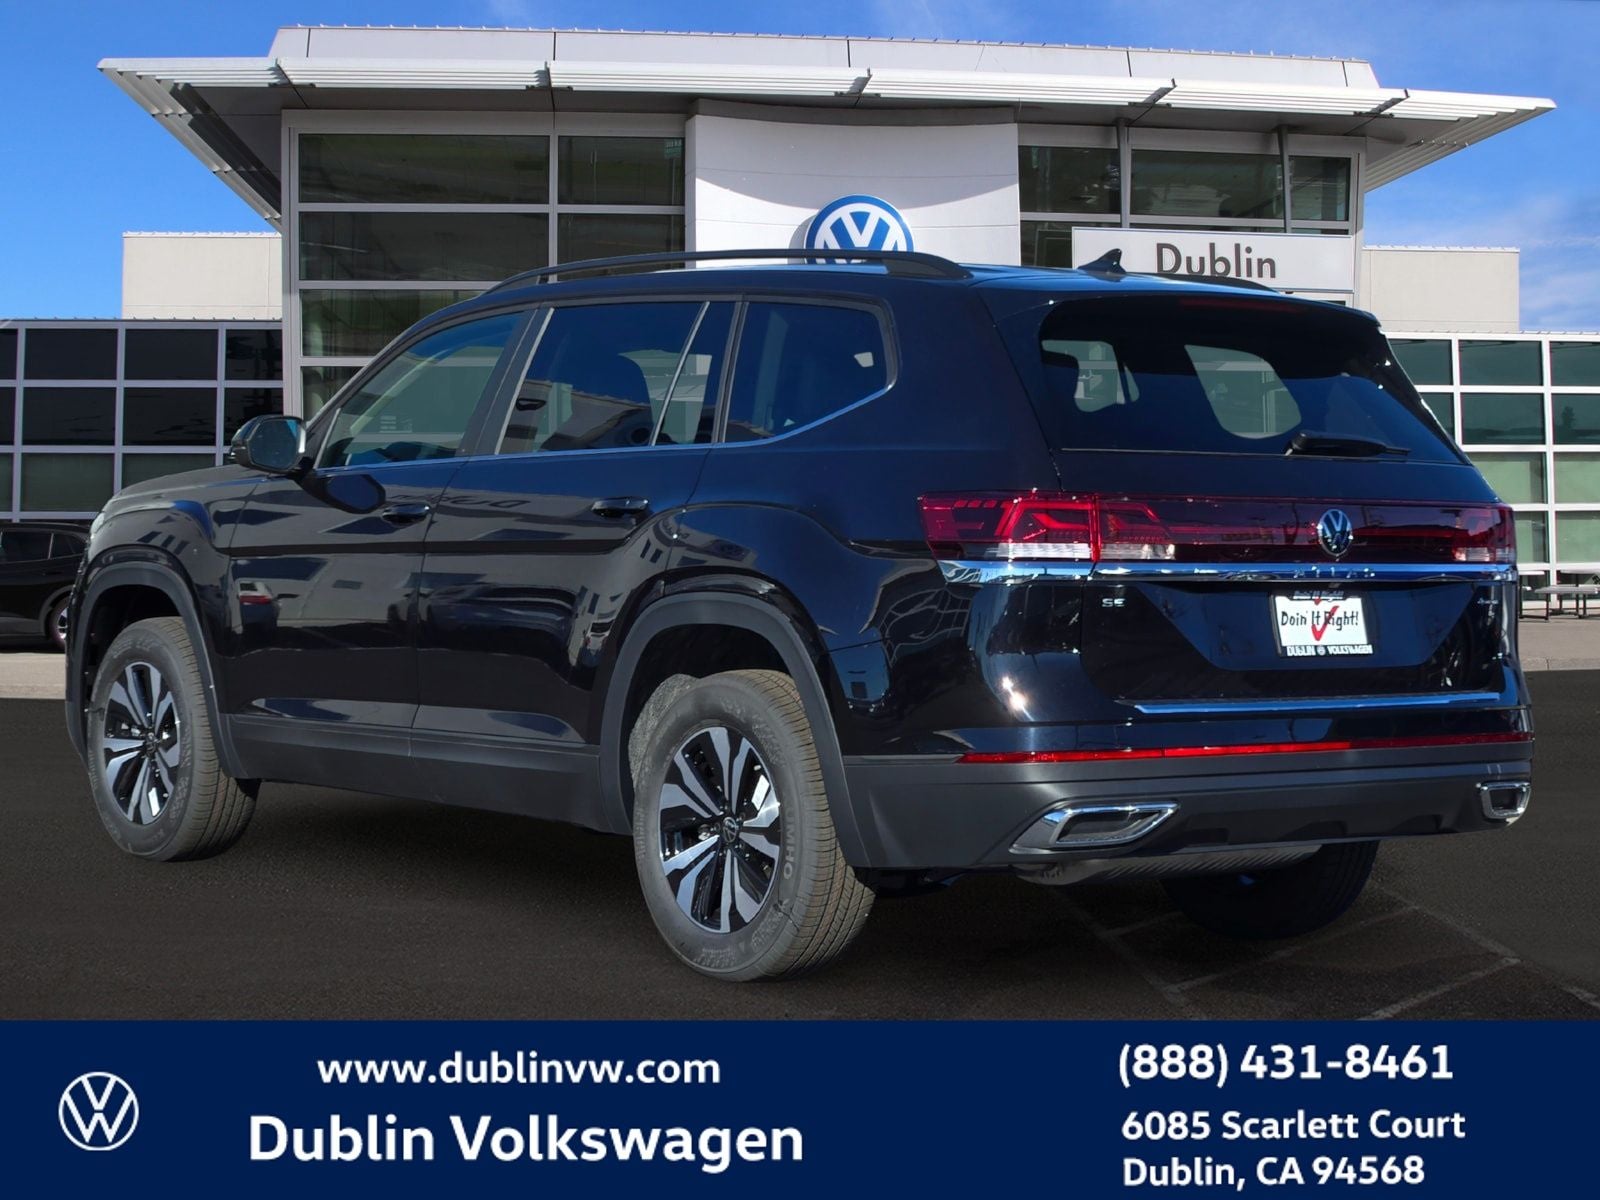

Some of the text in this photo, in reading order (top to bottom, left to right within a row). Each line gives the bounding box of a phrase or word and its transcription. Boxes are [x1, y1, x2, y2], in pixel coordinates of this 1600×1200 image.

[1156, 242, 1276, 279] Dublin
[1102, 598, 1125, 608] SE
[1281, 610, 1359, 631] Doin' It Right!
[1286, 645, 1316, 656] DUBLIN
